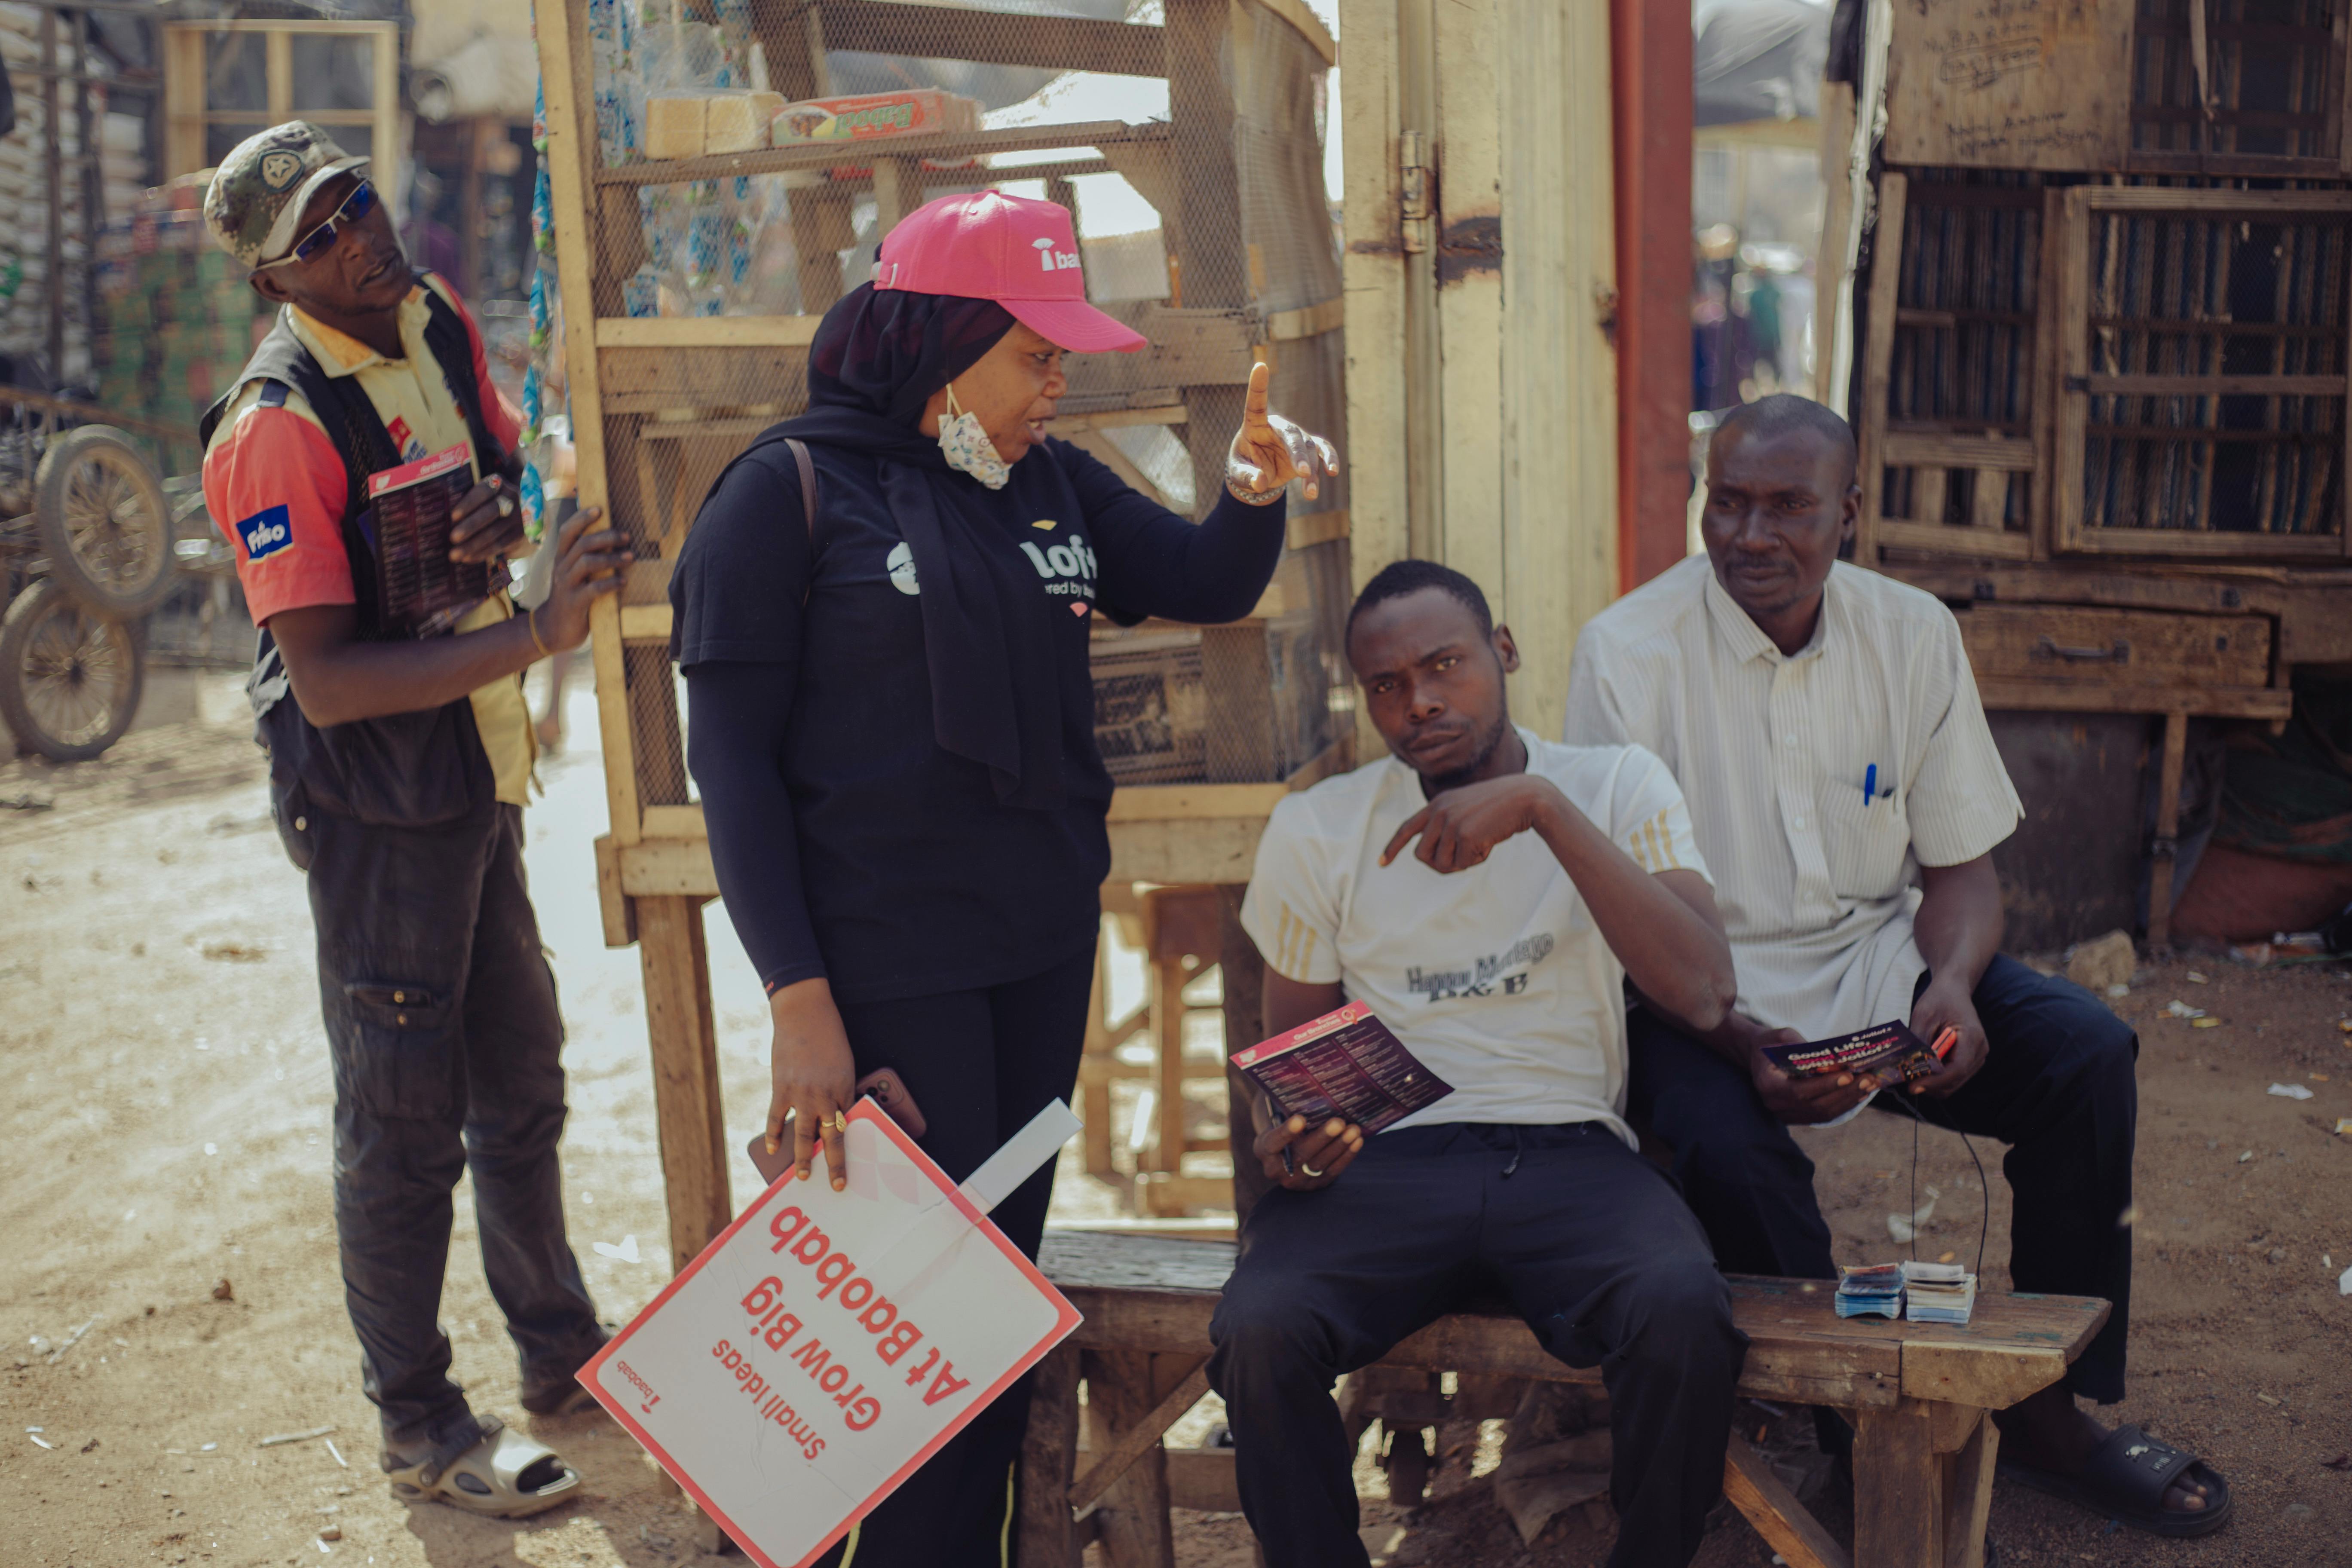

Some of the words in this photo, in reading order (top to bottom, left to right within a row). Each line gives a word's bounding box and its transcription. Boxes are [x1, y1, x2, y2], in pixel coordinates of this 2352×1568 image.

[832, 102, 914, 136] Babool
[1045, 582, 1069, 594] red
[1069, 582, 1081, 597] by
[1788, 1047, 1831, 1060] Good
[741, 1276, 803, 1351] Big
[770, 1206, 923, 1366] Baobab
[617, 1360, 653, 1399] baobab
[712, 1339, 770, 1403] Ideas
[791, 1339, 881, 1431] Grow
[905, 1347, 970, 1406] At
[762, 1395, 826, 1460] Small
